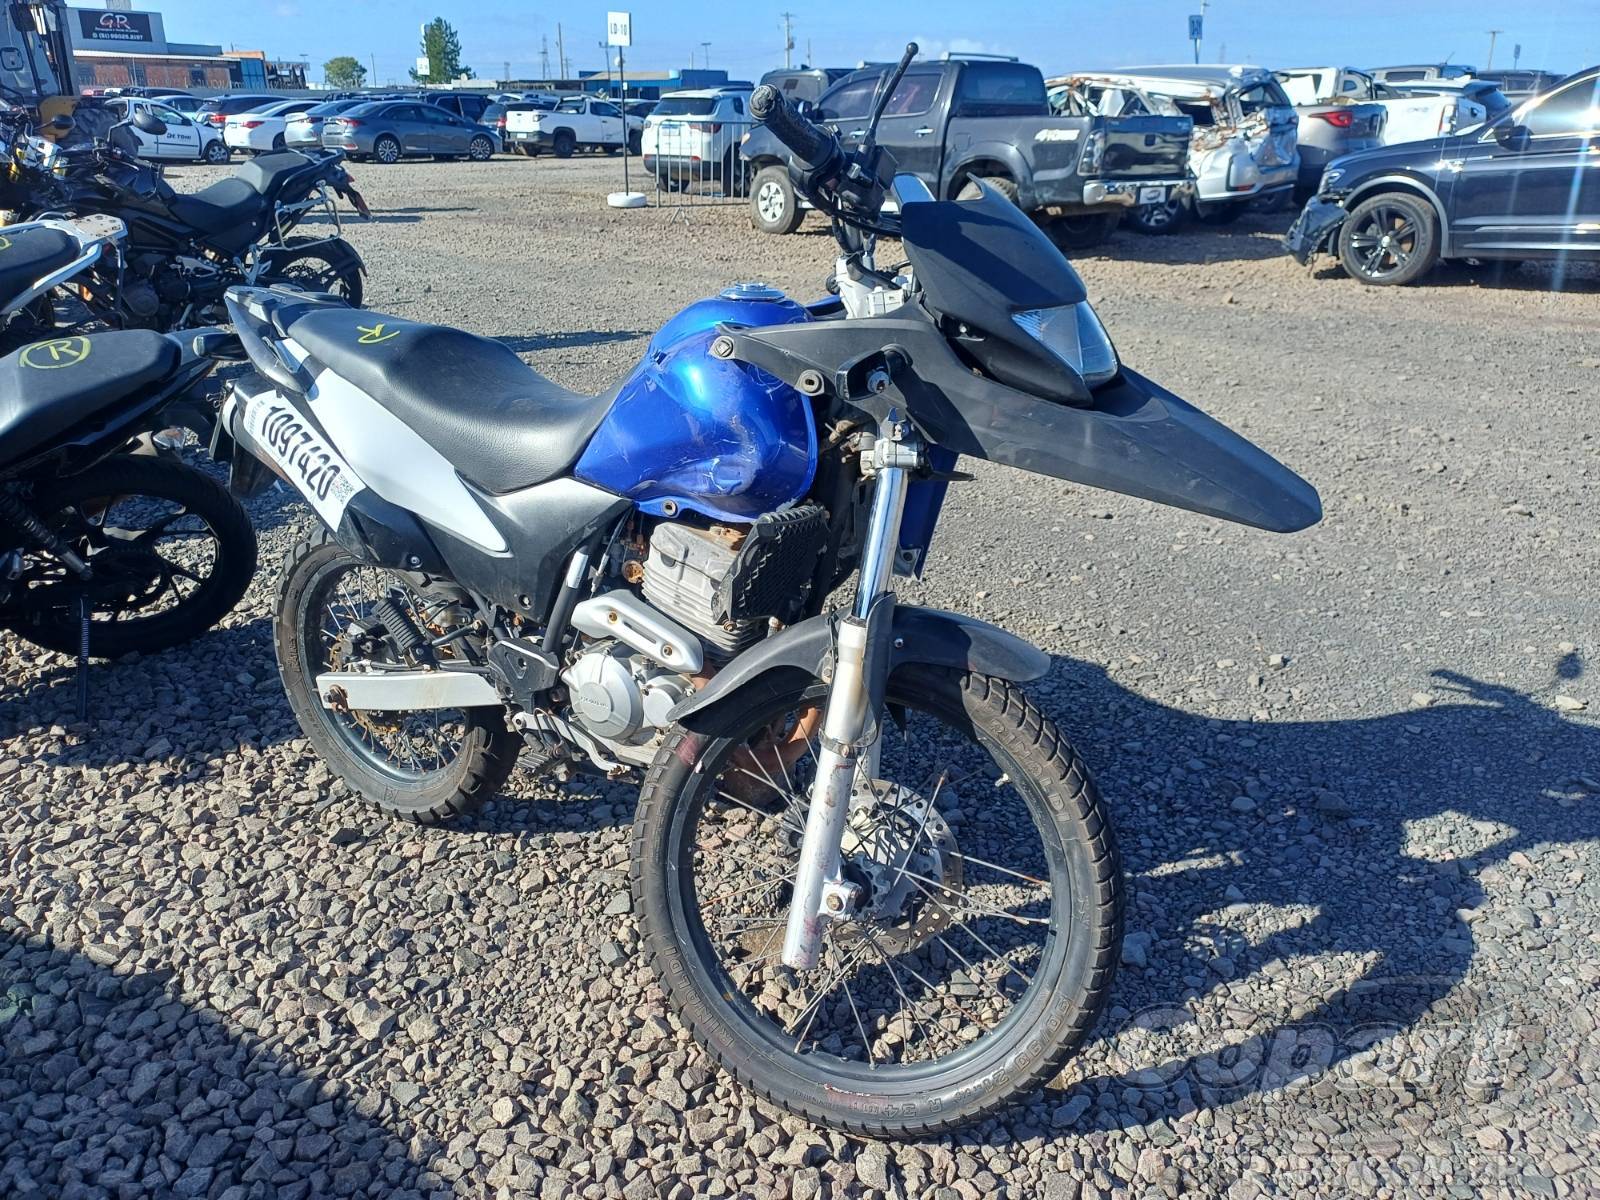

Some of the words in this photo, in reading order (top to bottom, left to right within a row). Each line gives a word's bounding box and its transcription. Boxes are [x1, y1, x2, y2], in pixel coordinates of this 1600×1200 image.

[261, 406, 341, 501] 1097420
[987, 719, 1072, 822] RINALDI
[663, 947, 735, 1048] RINALDI
